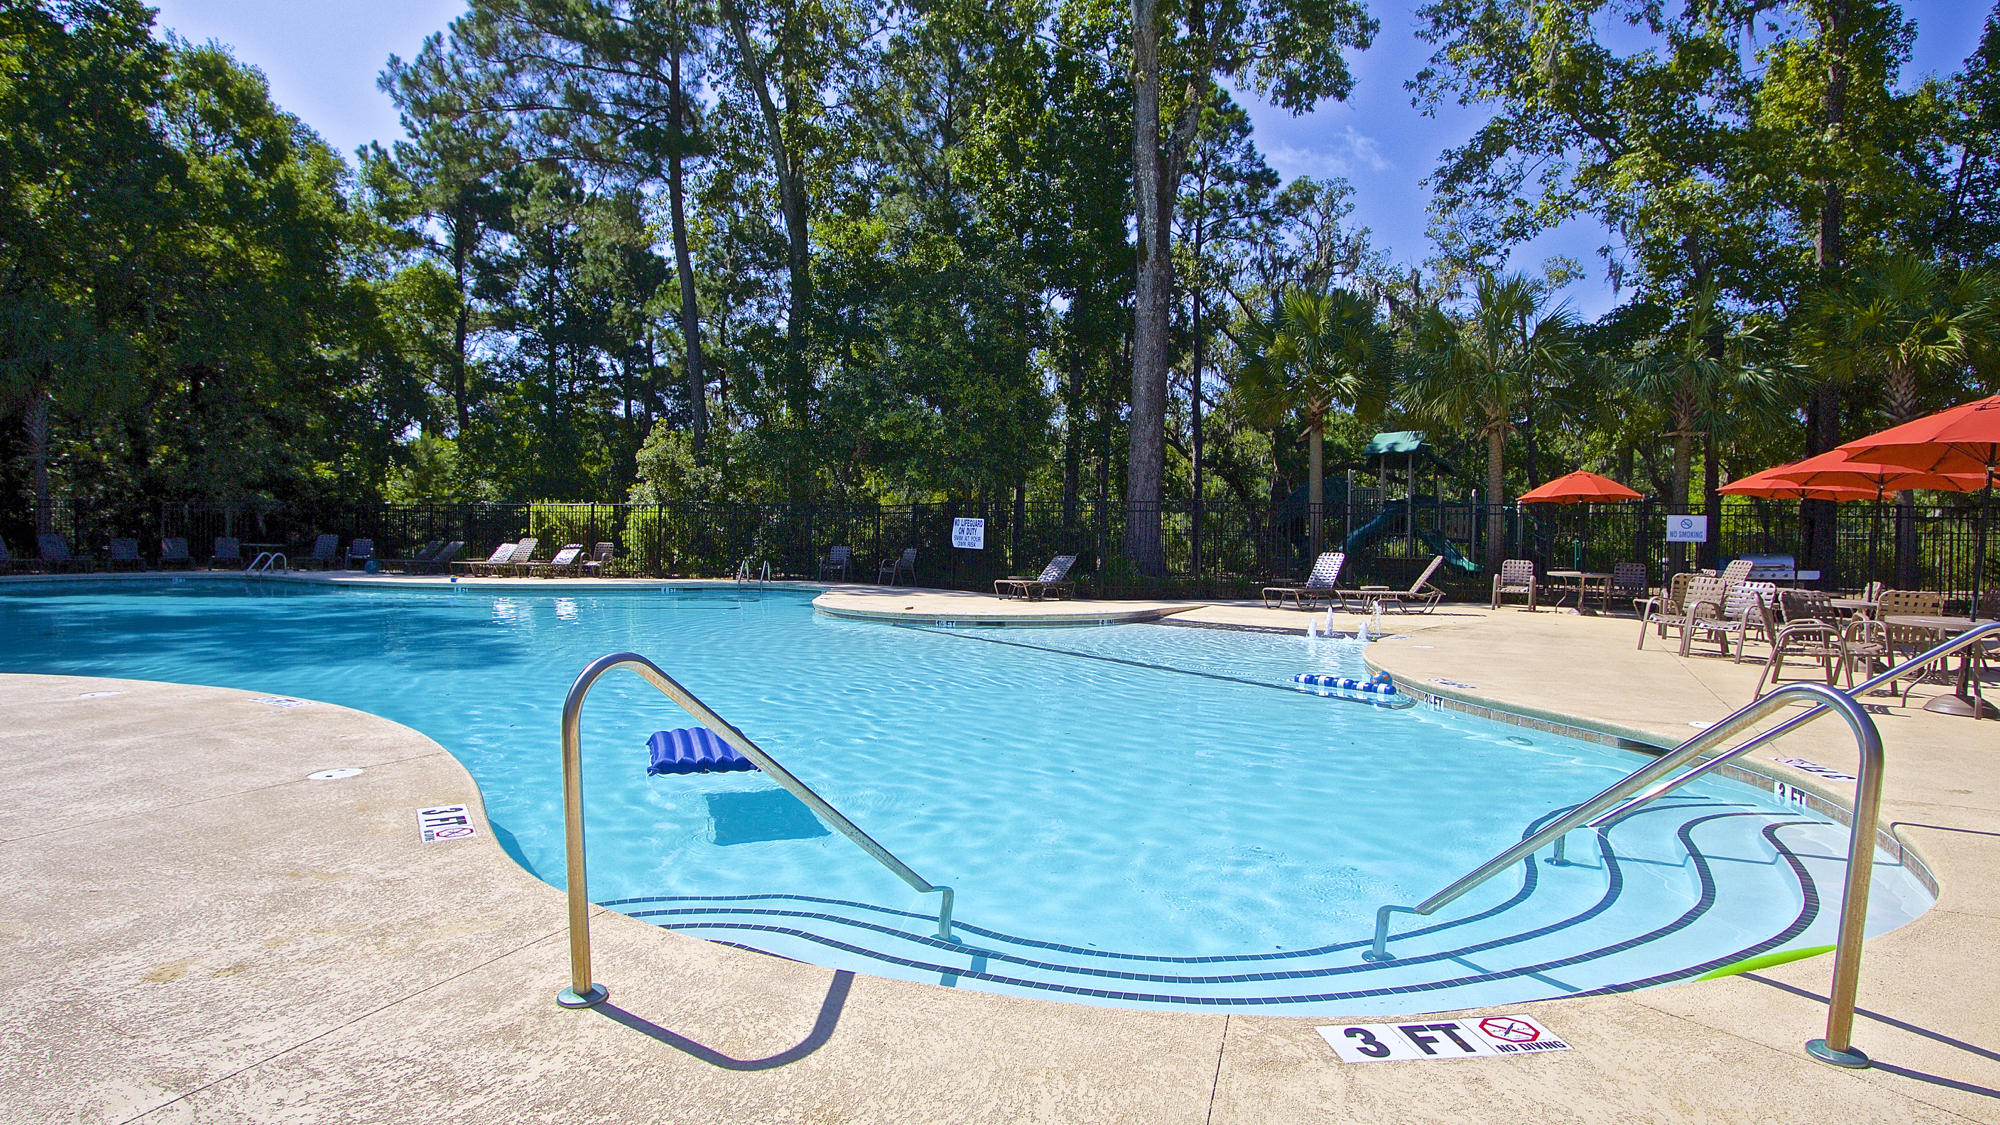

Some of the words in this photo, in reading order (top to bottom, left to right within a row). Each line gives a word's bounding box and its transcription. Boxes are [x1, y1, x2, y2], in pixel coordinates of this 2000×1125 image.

[961, 519, 983, 527] LIFEGUARD
[958, 526, 965, 534] ON
[1434, 696, 1443, 707] FT
[1791, 786, 1805, 805] FT
[422, 807, 463, 815] 3
[424, 816, 467, 827] FT
[1343, 1027, 1391, 1058] 3
[1398, 1022, 1477, 1055] FT
[1496, 1044, 1518, 1052] NO
[1518, 1040, 1567, 1051] DIVING
